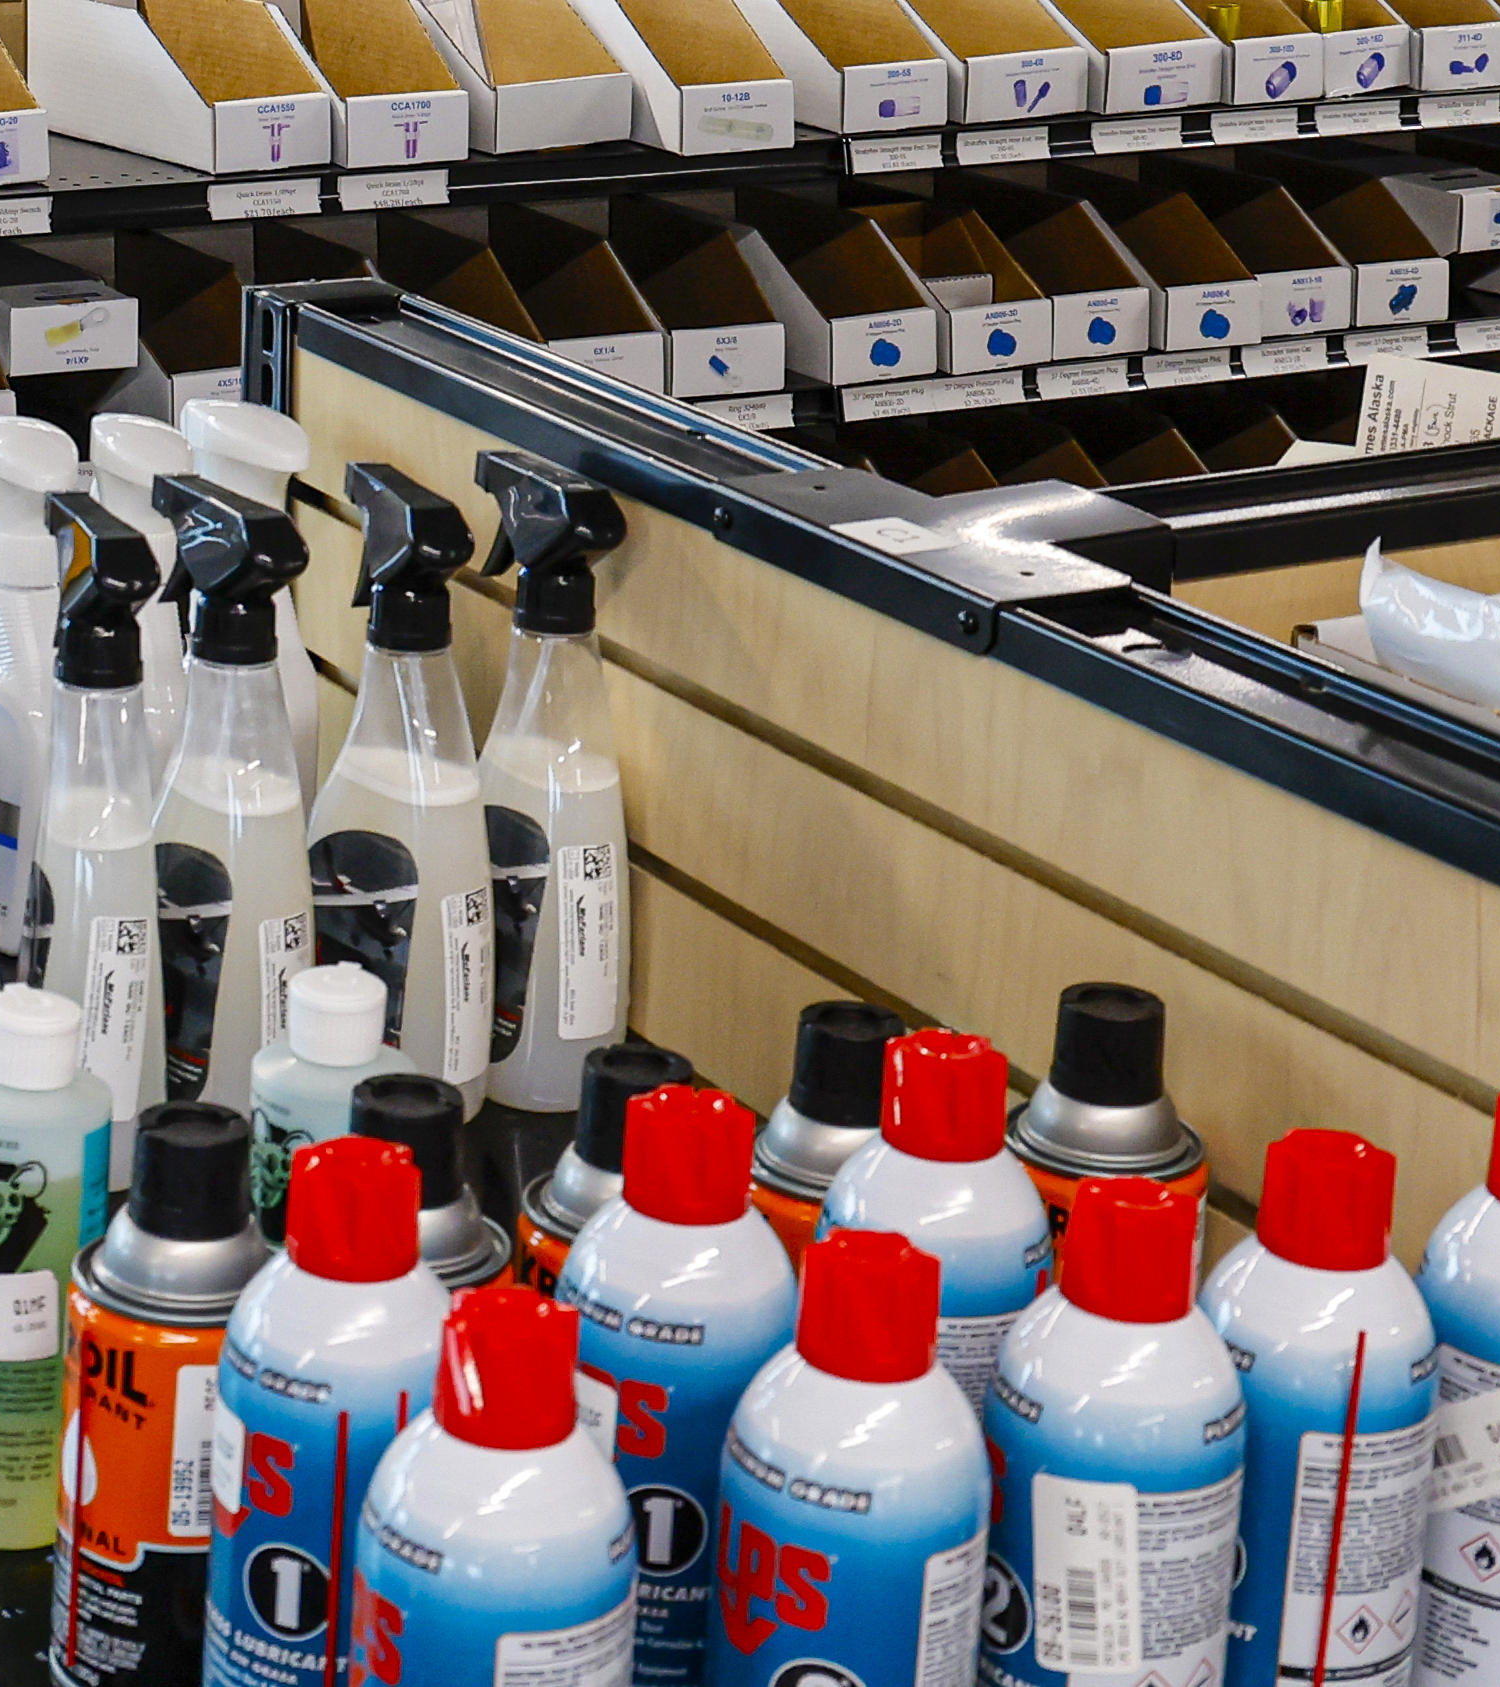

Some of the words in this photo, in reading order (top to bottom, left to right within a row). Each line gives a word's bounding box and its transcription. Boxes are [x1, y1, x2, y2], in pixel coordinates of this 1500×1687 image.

[721, 91, 751, 103] 10-12B
[256, 102, 296, 115] CCA1550
[391, 98, 432, 112] CCA1700
[366, 180, 384, 190] Quick
[237, 191, 255, 200] Quick
[1080, 368, 1104, 377] Pressure
[1105, 366, 1118, 375] Plug
[954, 381, 975, 391] Degree
[976, 379, 1000, 388] Pressure
[1001, 378, 1015, 387] Plug
[862, 392, 883, 402] Degree
[884, 389, 909, 398] Pressure
[910, 388, 925, 397] Plug
[1371, 374, 1384, 423] Alaska
[1484, 395, 1499, 439] ACKAGE
[76, 467, 93, 478] Ring
[627, 1318, 704, 1345] GRADE
[790, 1478, 872, 1514] GRADE
[643, 1497, 679, 1565] 1
[717, 1502, 832, 1632] LPS
[271, 1557, 303, 1630] 1
